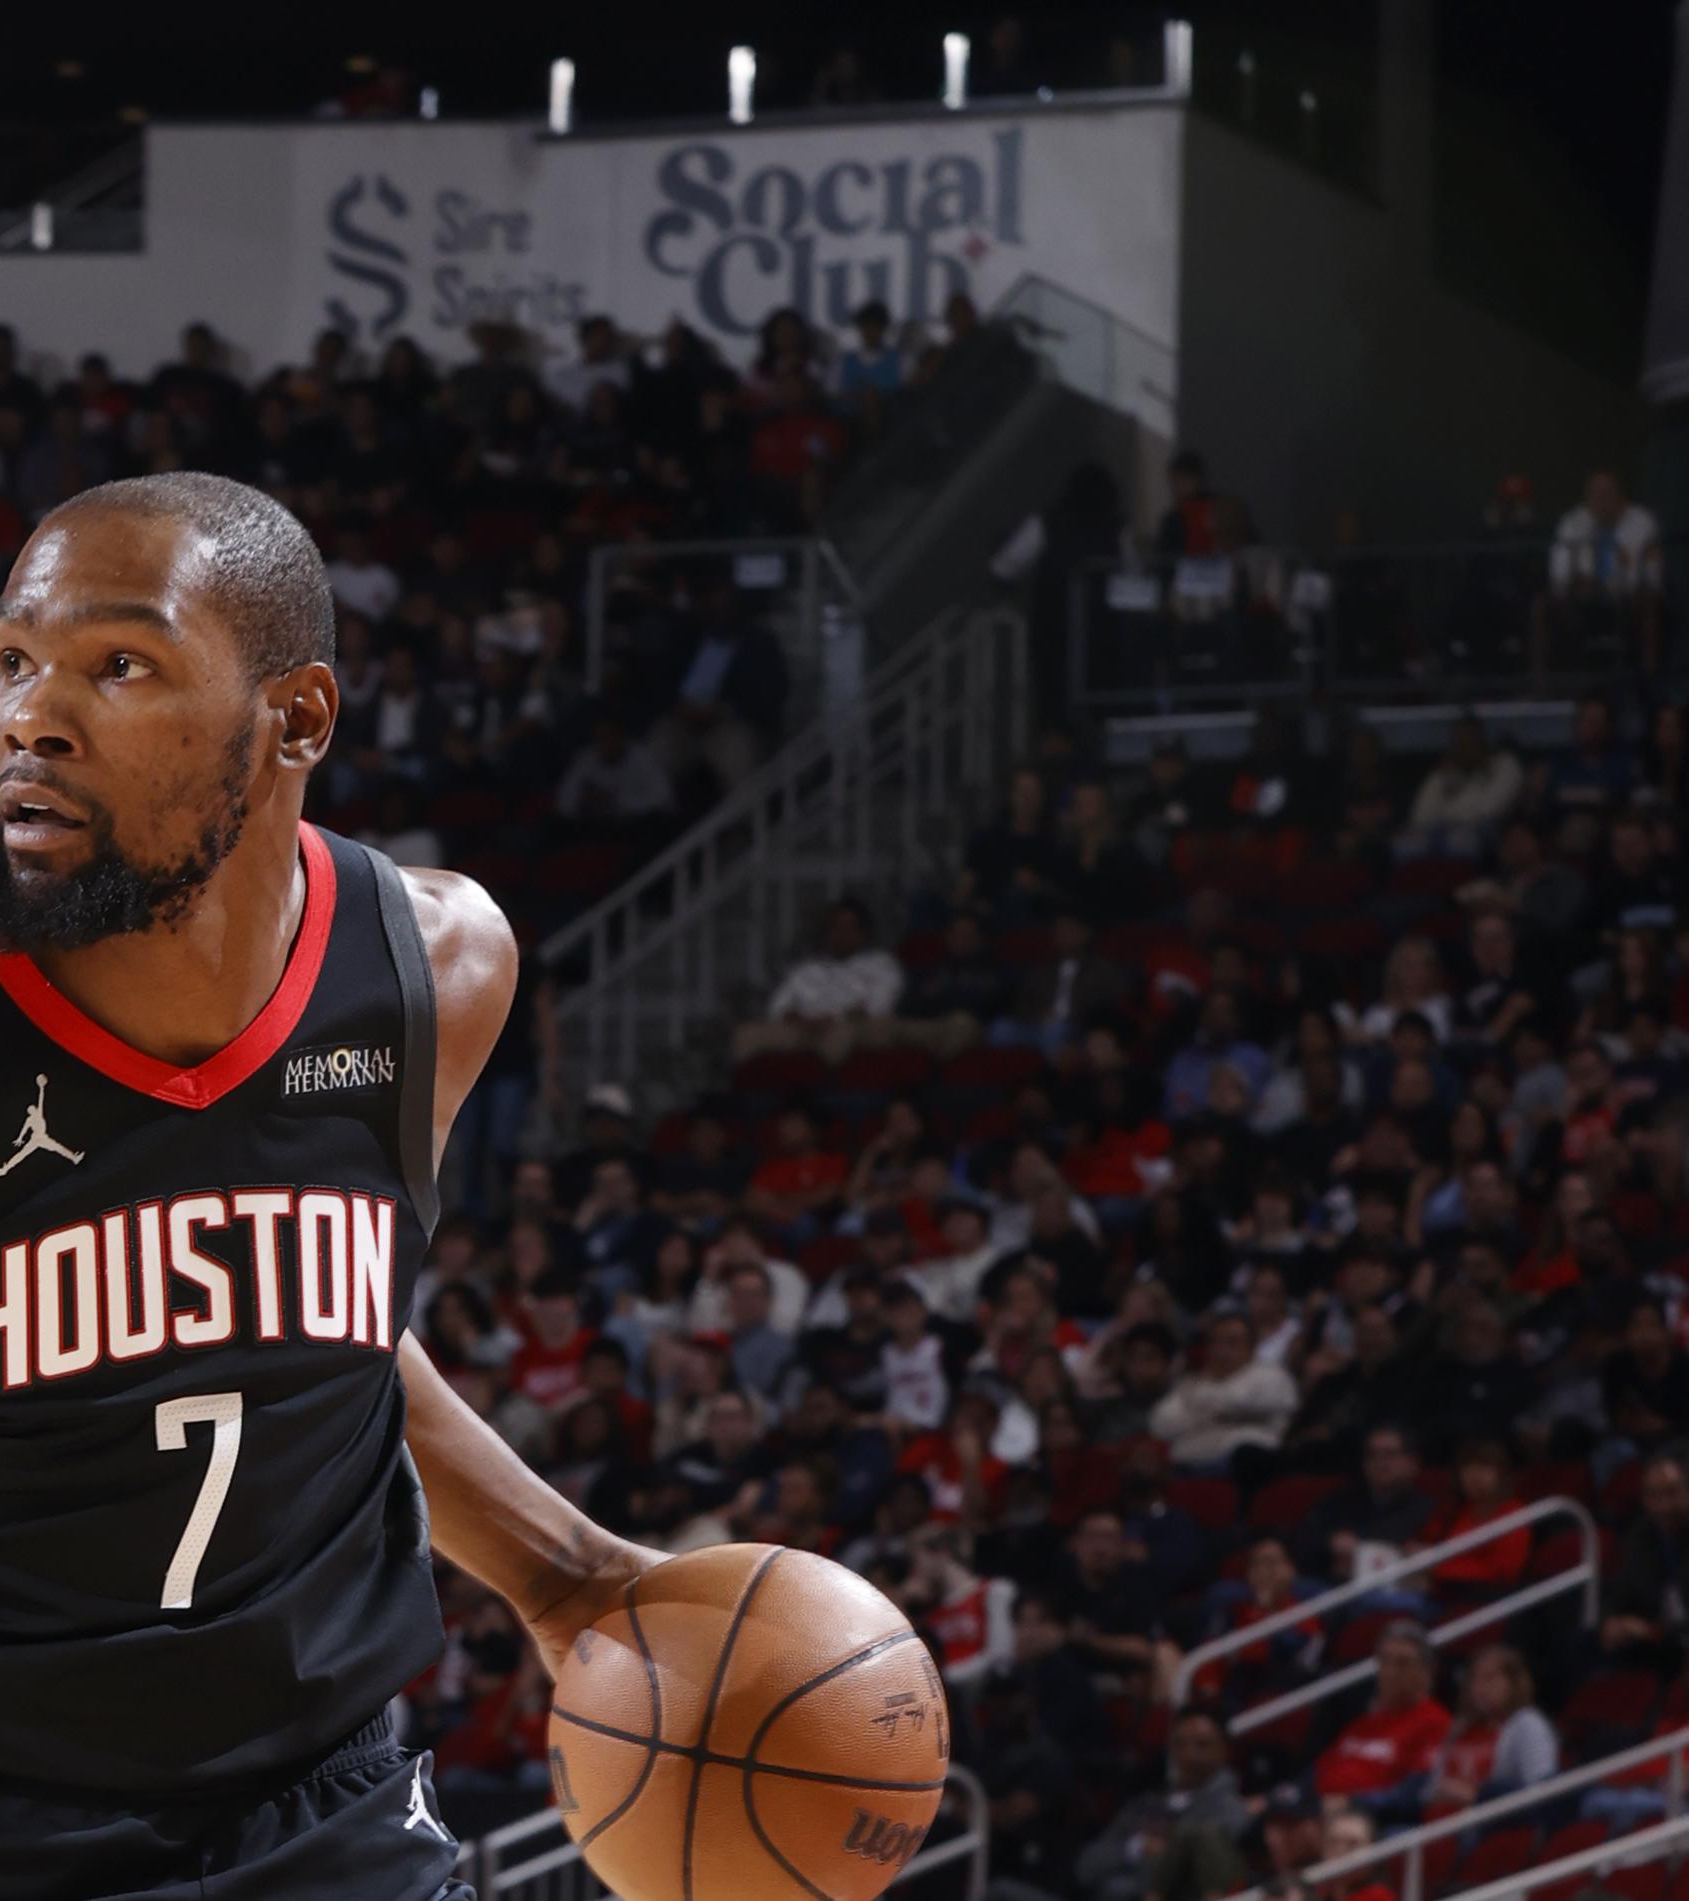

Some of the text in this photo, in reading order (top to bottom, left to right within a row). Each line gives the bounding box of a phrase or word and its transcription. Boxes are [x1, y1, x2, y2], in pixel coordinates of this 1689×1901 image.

[643, 127, 1024, 276] Social
[692, 222, 970, 337] Club
[285, 1063, 395, 1095] HERMANN
[286, 1046, 395, 1076] MEMORIAL
[155, 1391, 242, 1609] 7
